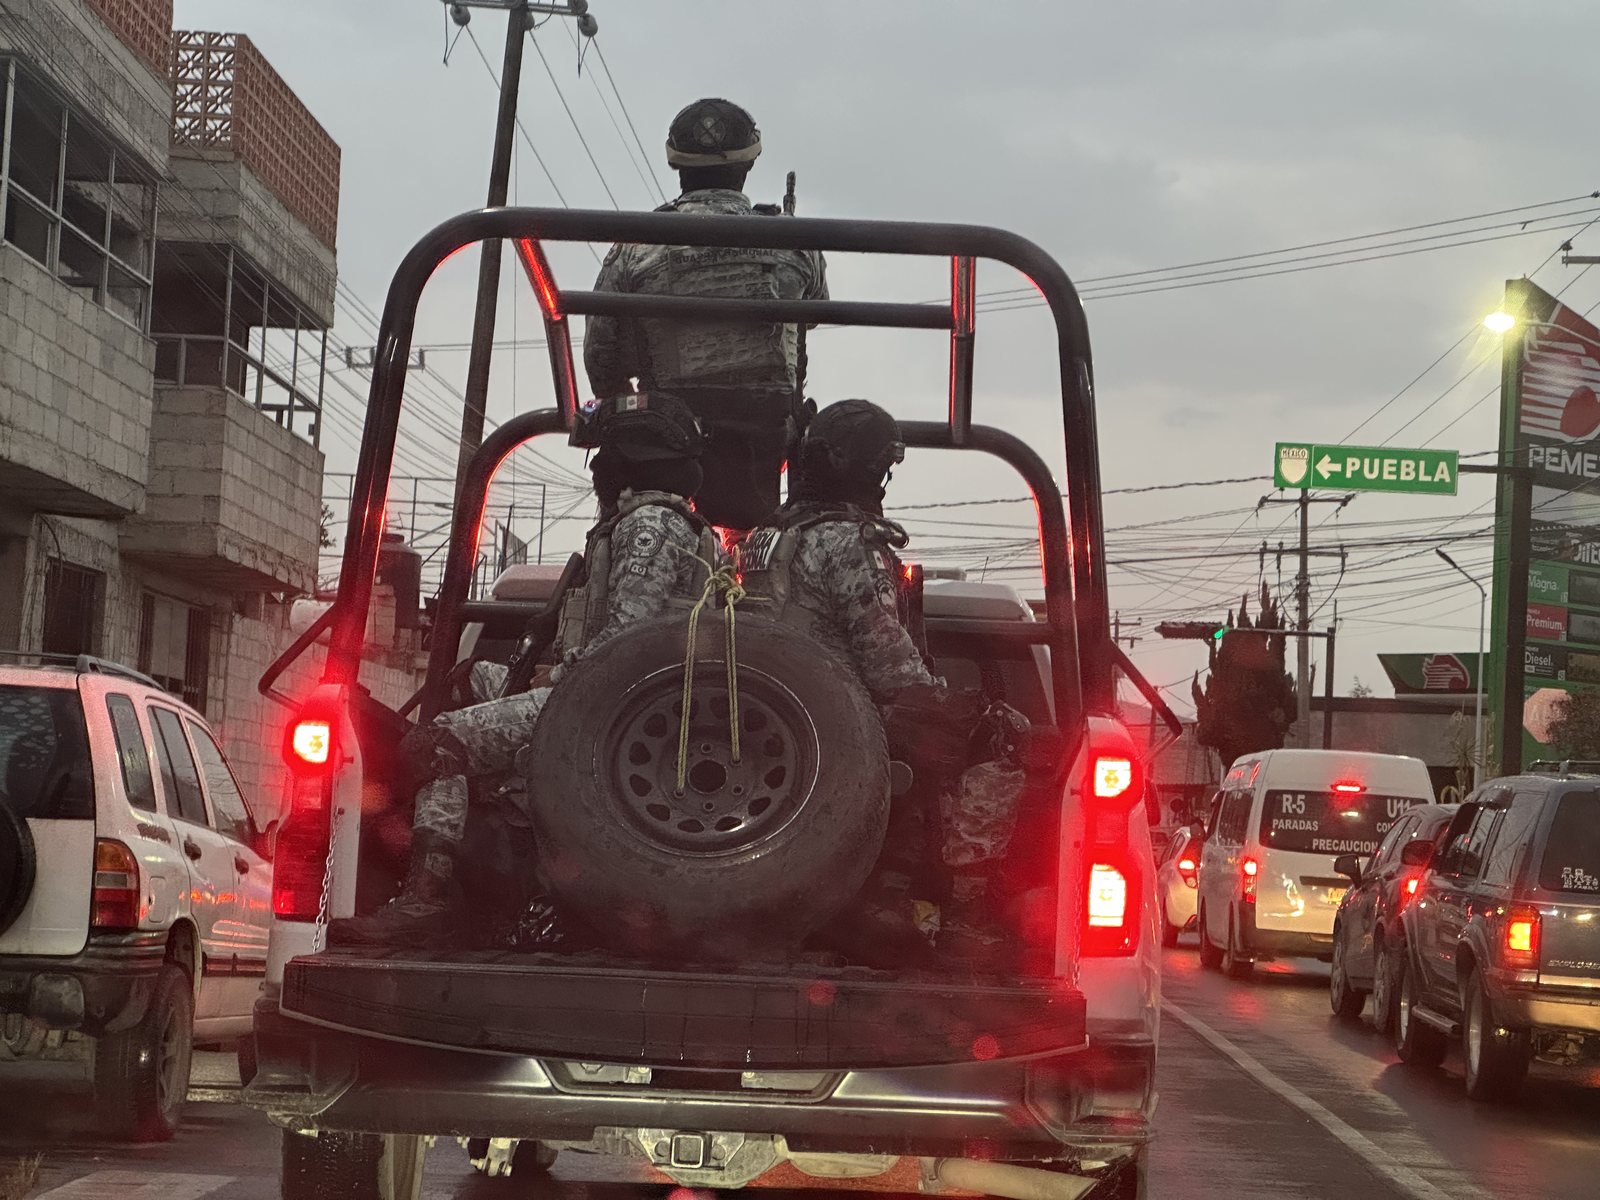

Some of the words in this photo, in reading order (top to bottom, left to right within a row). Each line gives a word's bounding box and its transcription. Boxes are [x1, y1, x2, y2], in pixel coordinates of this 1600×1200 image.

[1345, 457, 1451, 483] PUEBLA
[1528, 443, 1600, 479] PEME
[1527, 574, 1558, 593] Magna
[1526, 614, 1563, 631] Premium
[1524, 651, 1552, 667] Diesel
[1281, 793, 1306, 815] R-5
[1271, 818, 1319, 832] PARADAS
[1311, 838, 1380, 853] PRECAUCION
